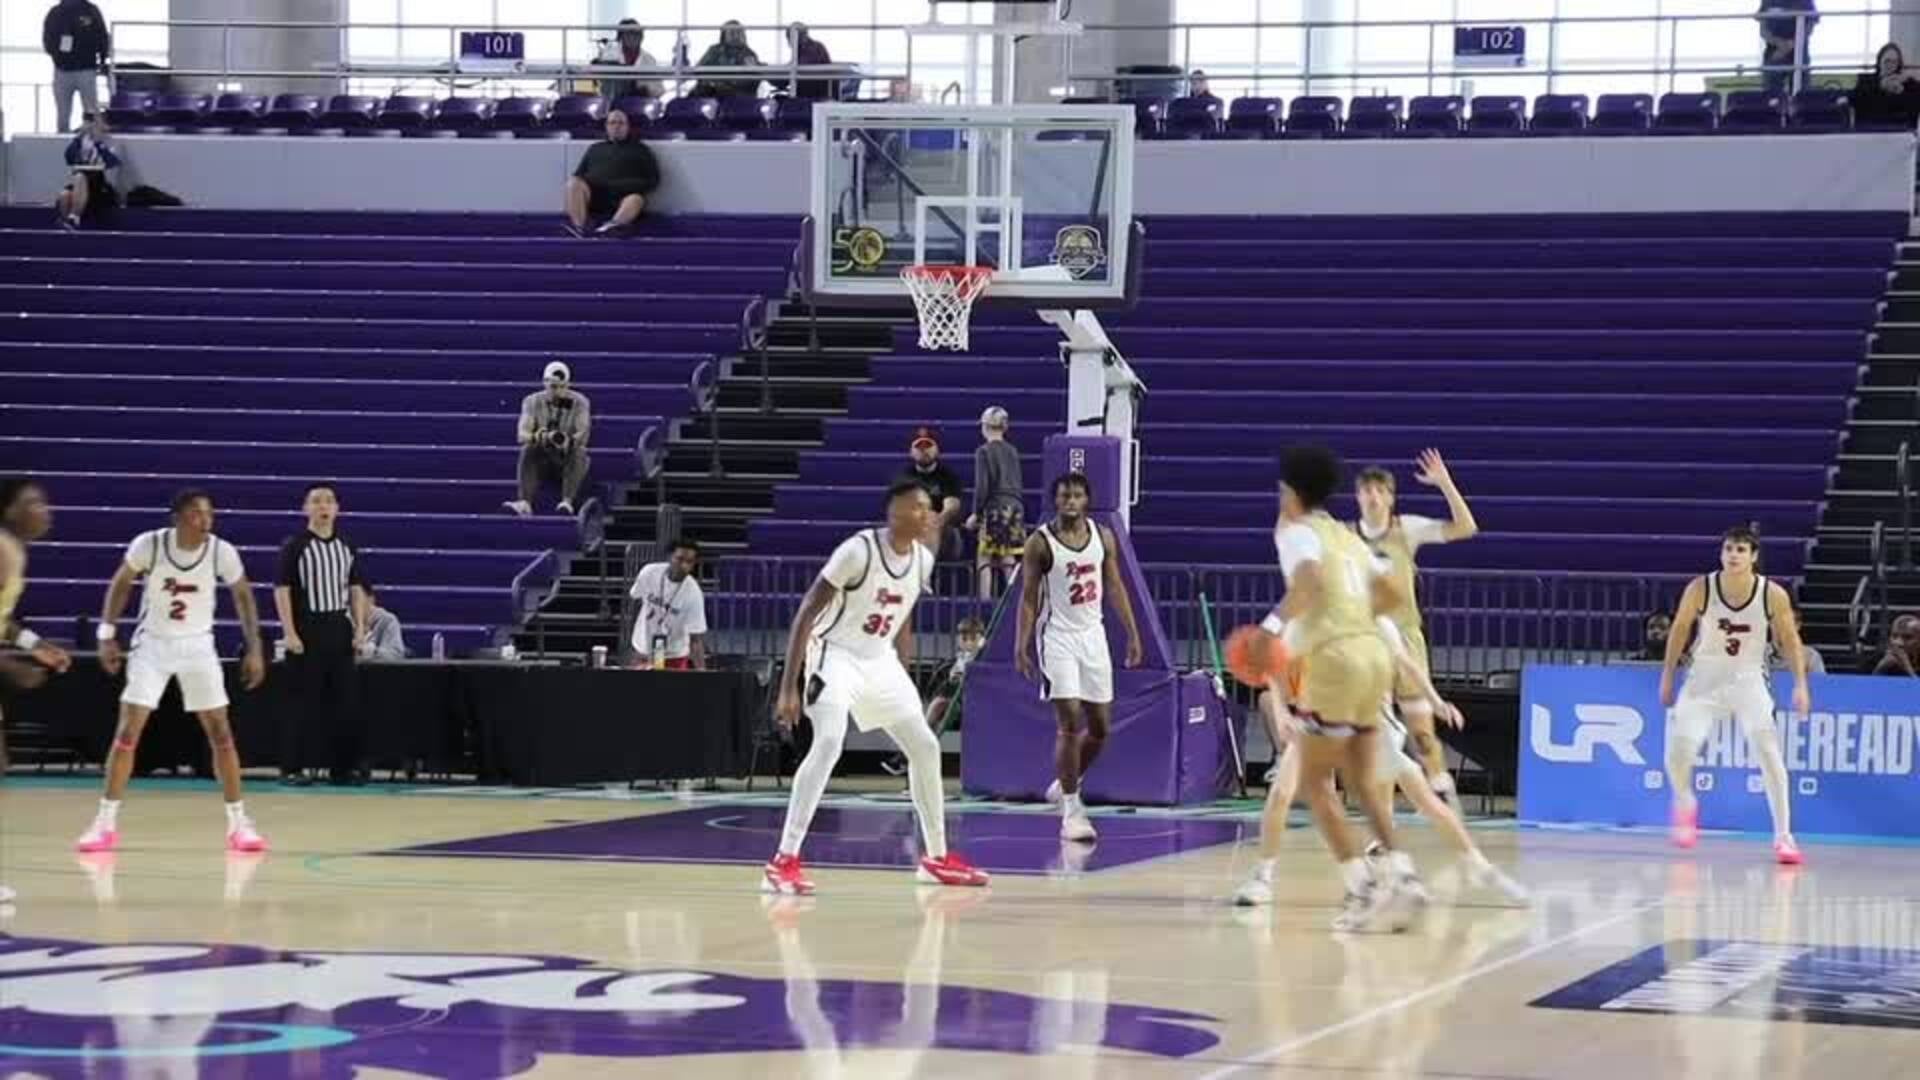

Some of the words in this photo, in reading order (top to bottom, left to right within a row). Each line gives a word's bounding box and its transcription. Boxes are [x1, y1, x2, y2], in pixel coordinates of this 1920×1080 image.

[485, 36, 513, 53] 101
[1481, 31, 1514, 49] 102
[1069, 580, 1098, 605] 22
[168, 600, 187, 620] 2
[862, 613, 894, 638] 35
[1725, 637, 1741, 656] 3
